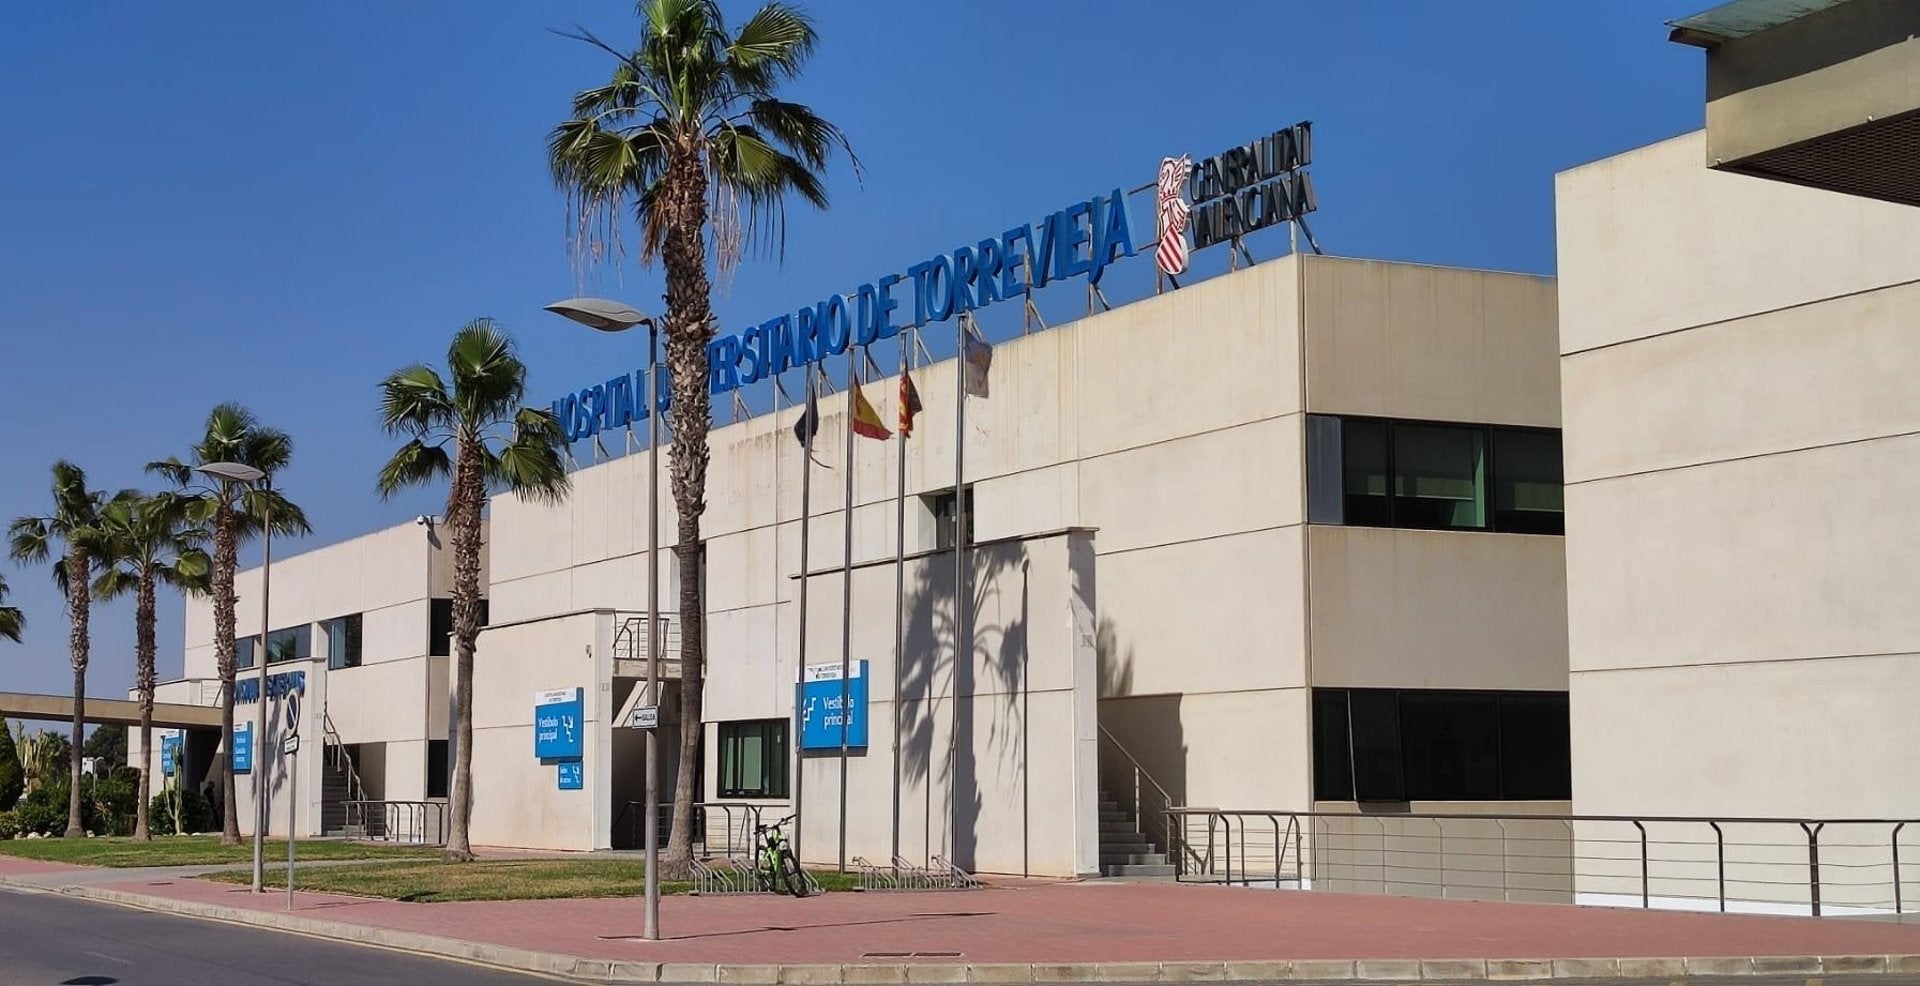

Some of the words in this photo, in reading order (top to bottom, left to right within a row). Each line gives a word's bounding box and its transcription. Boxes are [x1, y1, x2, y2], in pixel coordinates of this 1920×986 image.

[1190, 120, 1314, 202] GENERALITAT
[1190, 171, 1317, 248] VALENCIANA
[654, 293, 850, 411] UERSITARIO
[857, 274, 901, 347] DE
[908, 187, 1136, 327] TORREVIEJA
[823, 694, 855, 710] Vestíblo
[824, 711, 853, 730] princial
